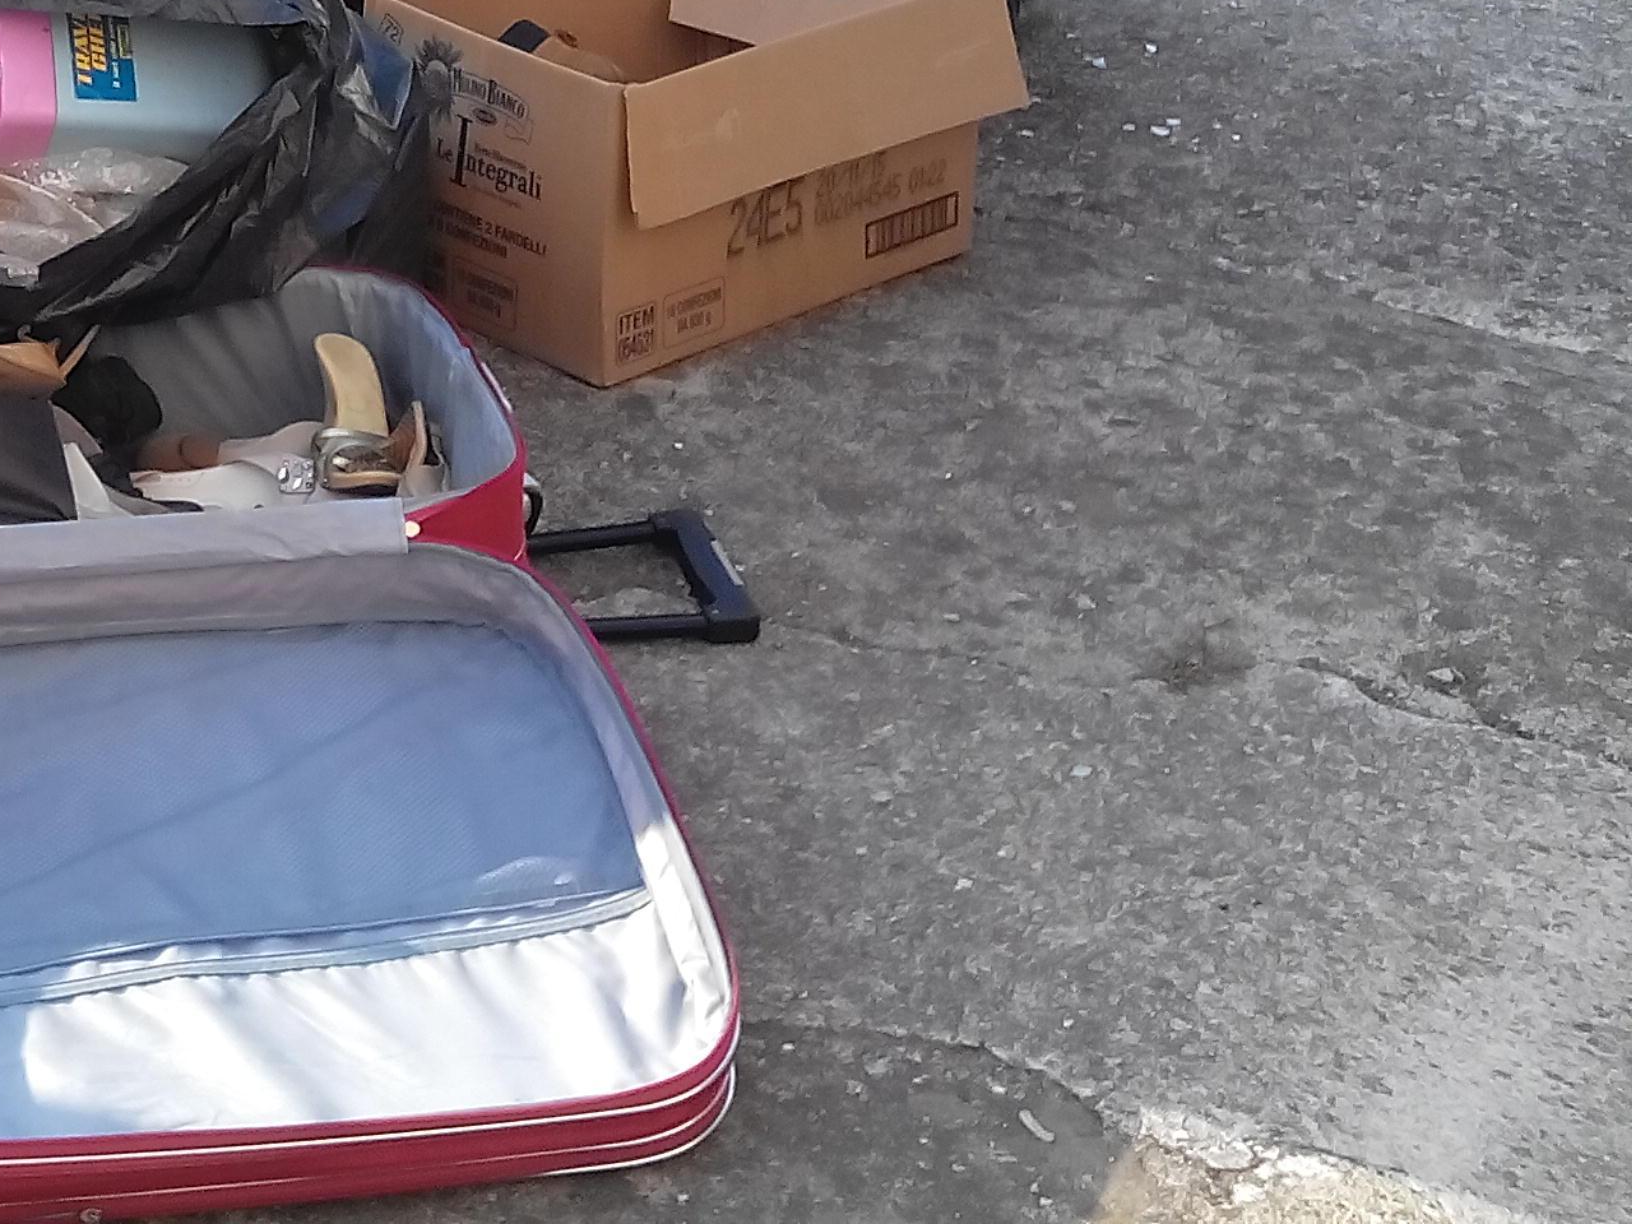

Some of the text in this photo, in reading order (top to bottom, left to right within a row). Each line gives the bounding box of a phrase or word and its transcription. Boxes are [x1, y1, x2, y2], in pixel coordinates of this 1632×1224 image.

[89, 14, 107, 72] CHE
[386, 19, 400, 42] 72
[72, 13, 92, 86] TRAV
[453, 66, 487, 101] MINO
[436, 137, 453, 163] Le
[450, 114, 542, 202] Integrali
[484, 222, 493, 236] 2
[495, 225, 547, 256] FARDELLI
[619, 305, 654, 335] ITEM
